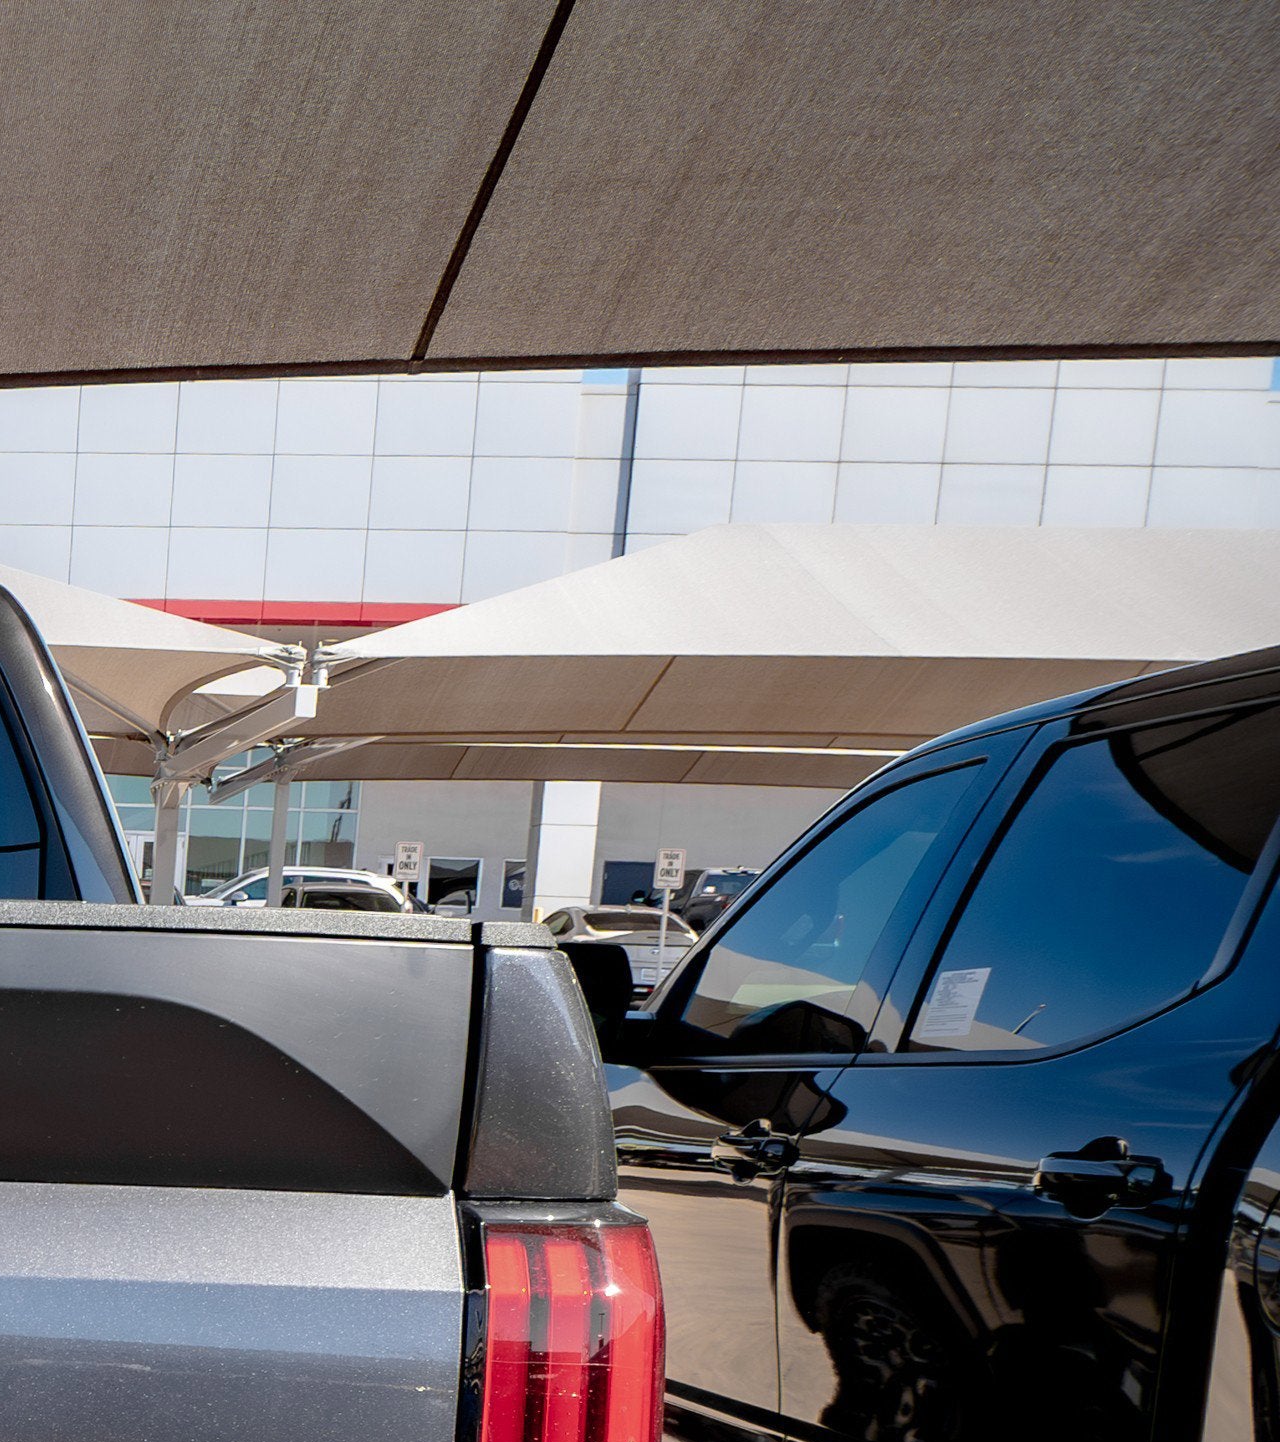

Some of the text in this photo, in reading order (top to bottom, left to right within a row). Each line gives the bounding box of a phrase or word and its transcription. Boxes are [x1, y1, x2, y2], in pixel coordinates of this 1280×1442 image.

[663, 852, 680, 860] TRADE
[399, 861, 418, 870] ONLY
[660, 868, 680, 877] ONLY
